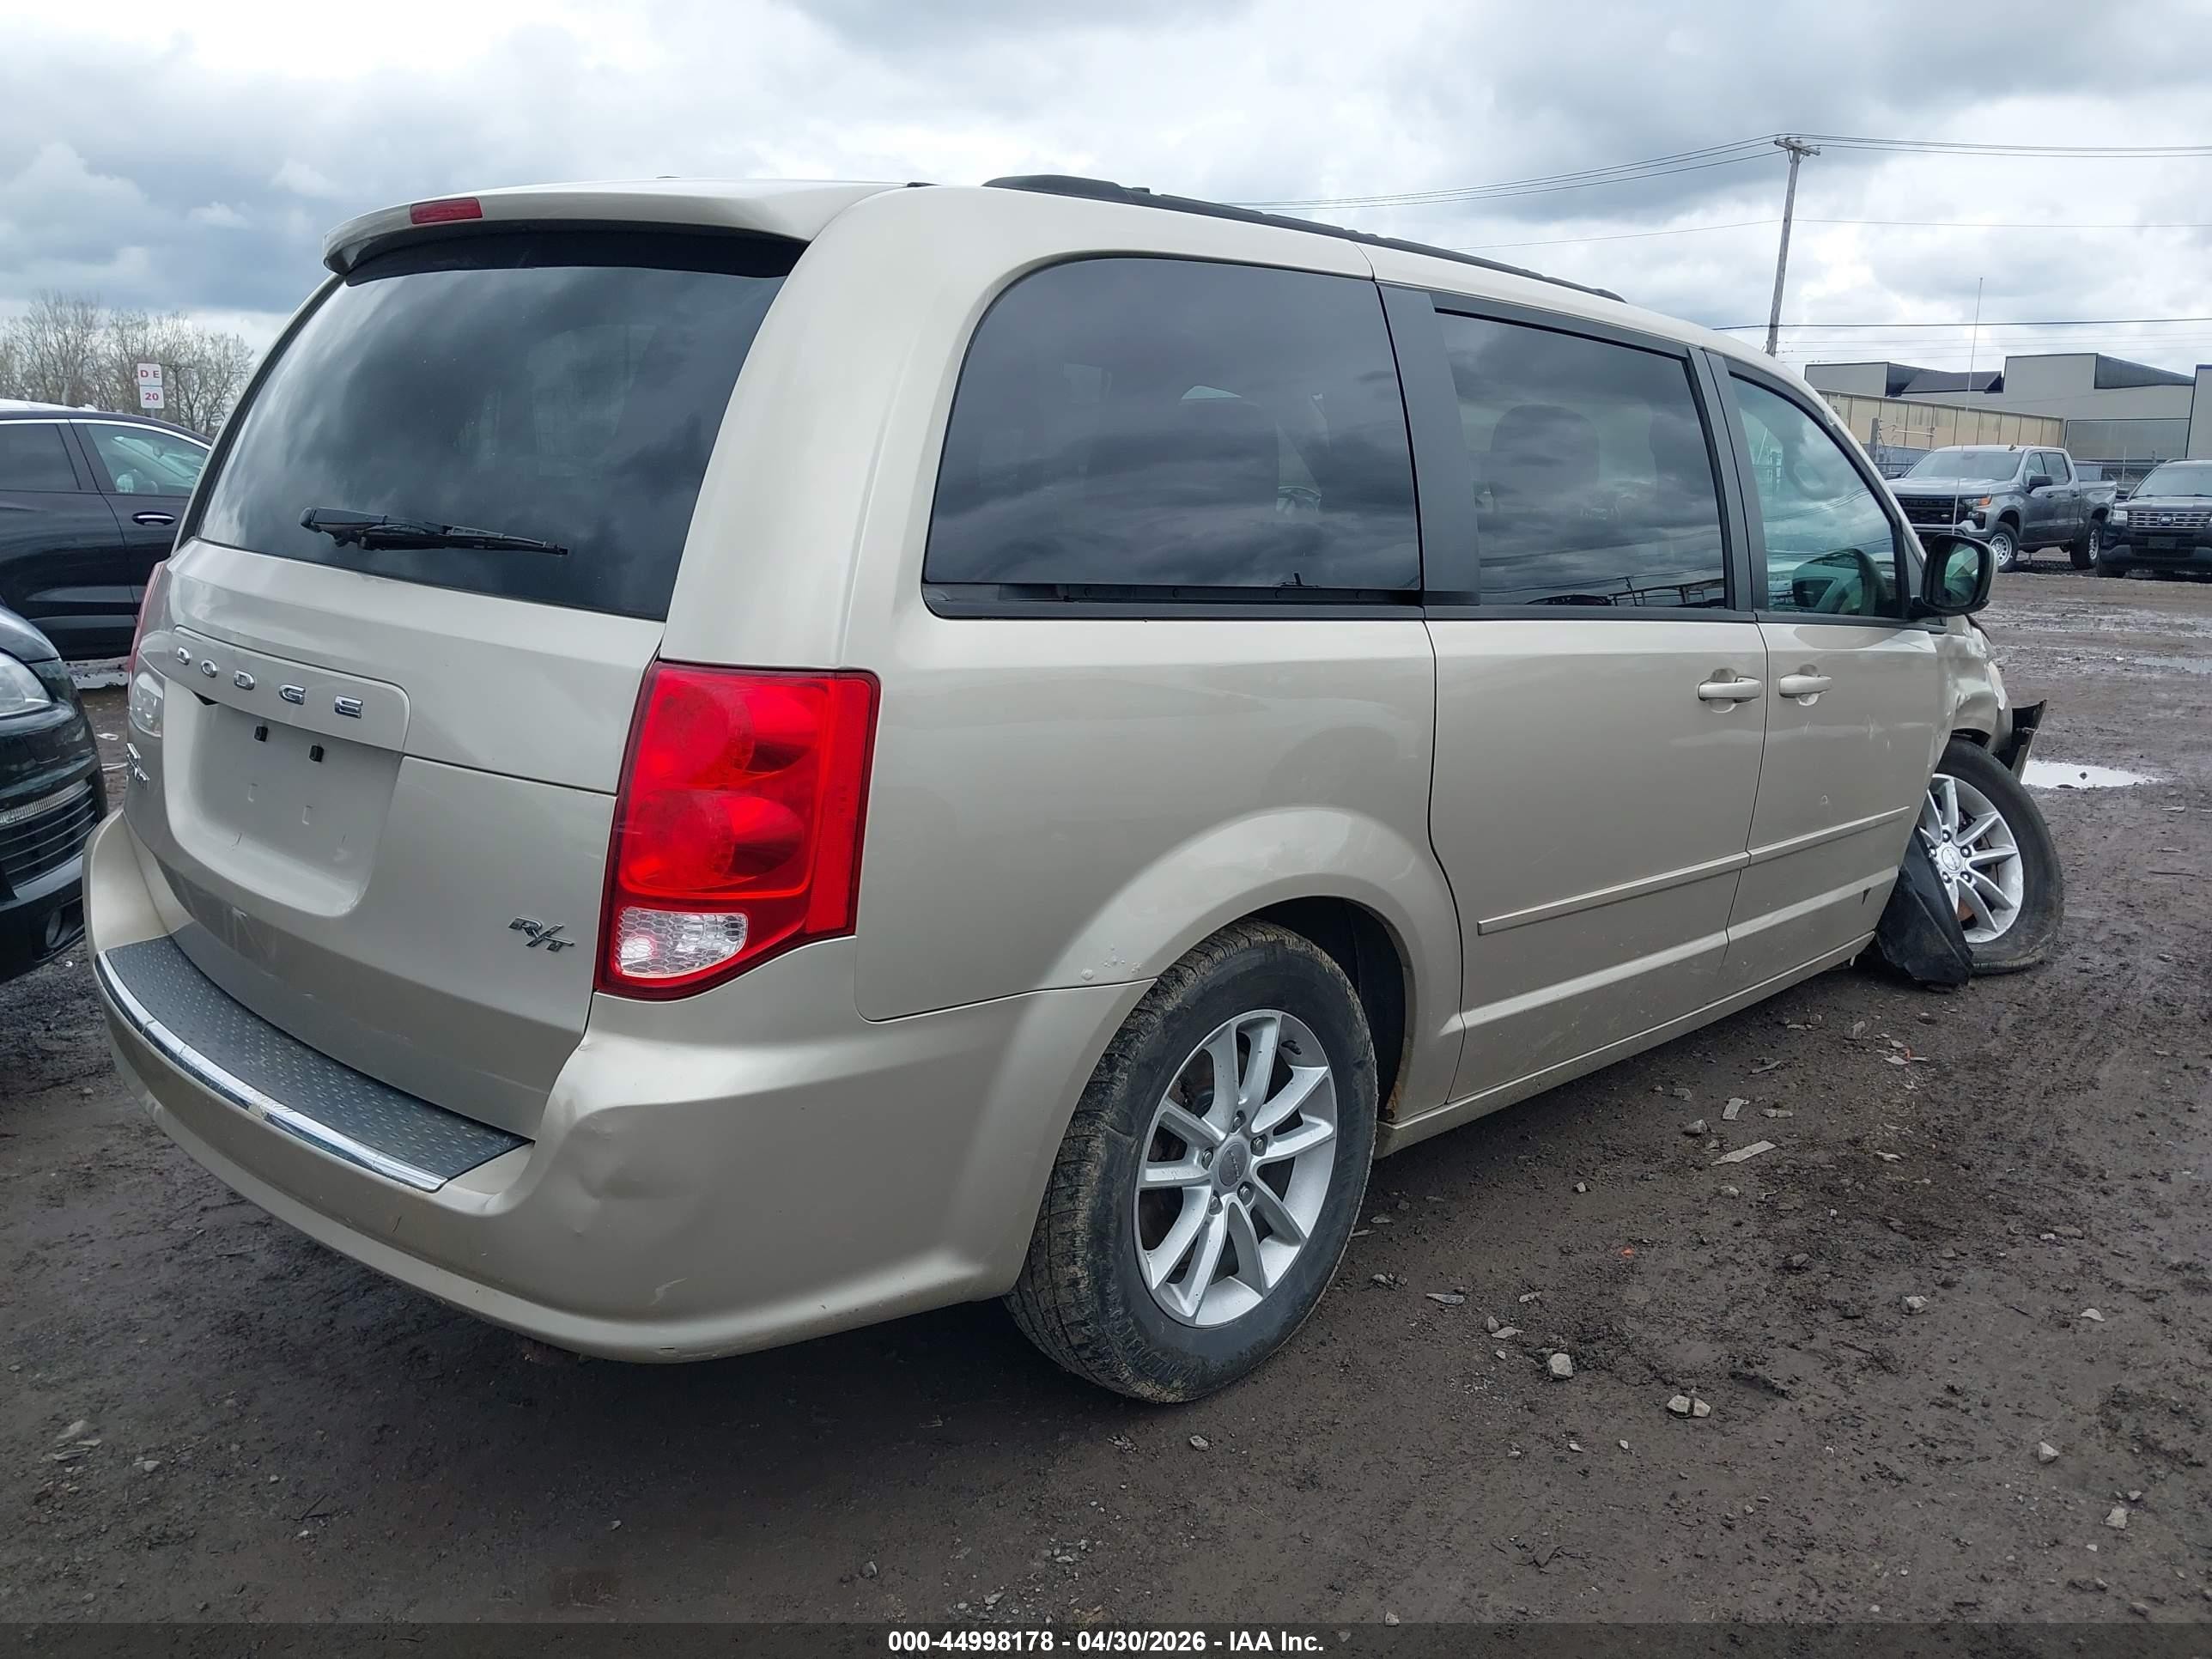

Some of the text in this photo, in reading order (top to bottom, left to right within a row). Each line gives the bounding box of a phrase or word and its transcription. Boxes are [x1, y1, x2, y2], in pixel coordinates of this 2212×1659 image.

[144, 392, 160, 401] 20
[177, 647, 363, 719] DODGE
[508, 915, 574, 952] R/T
